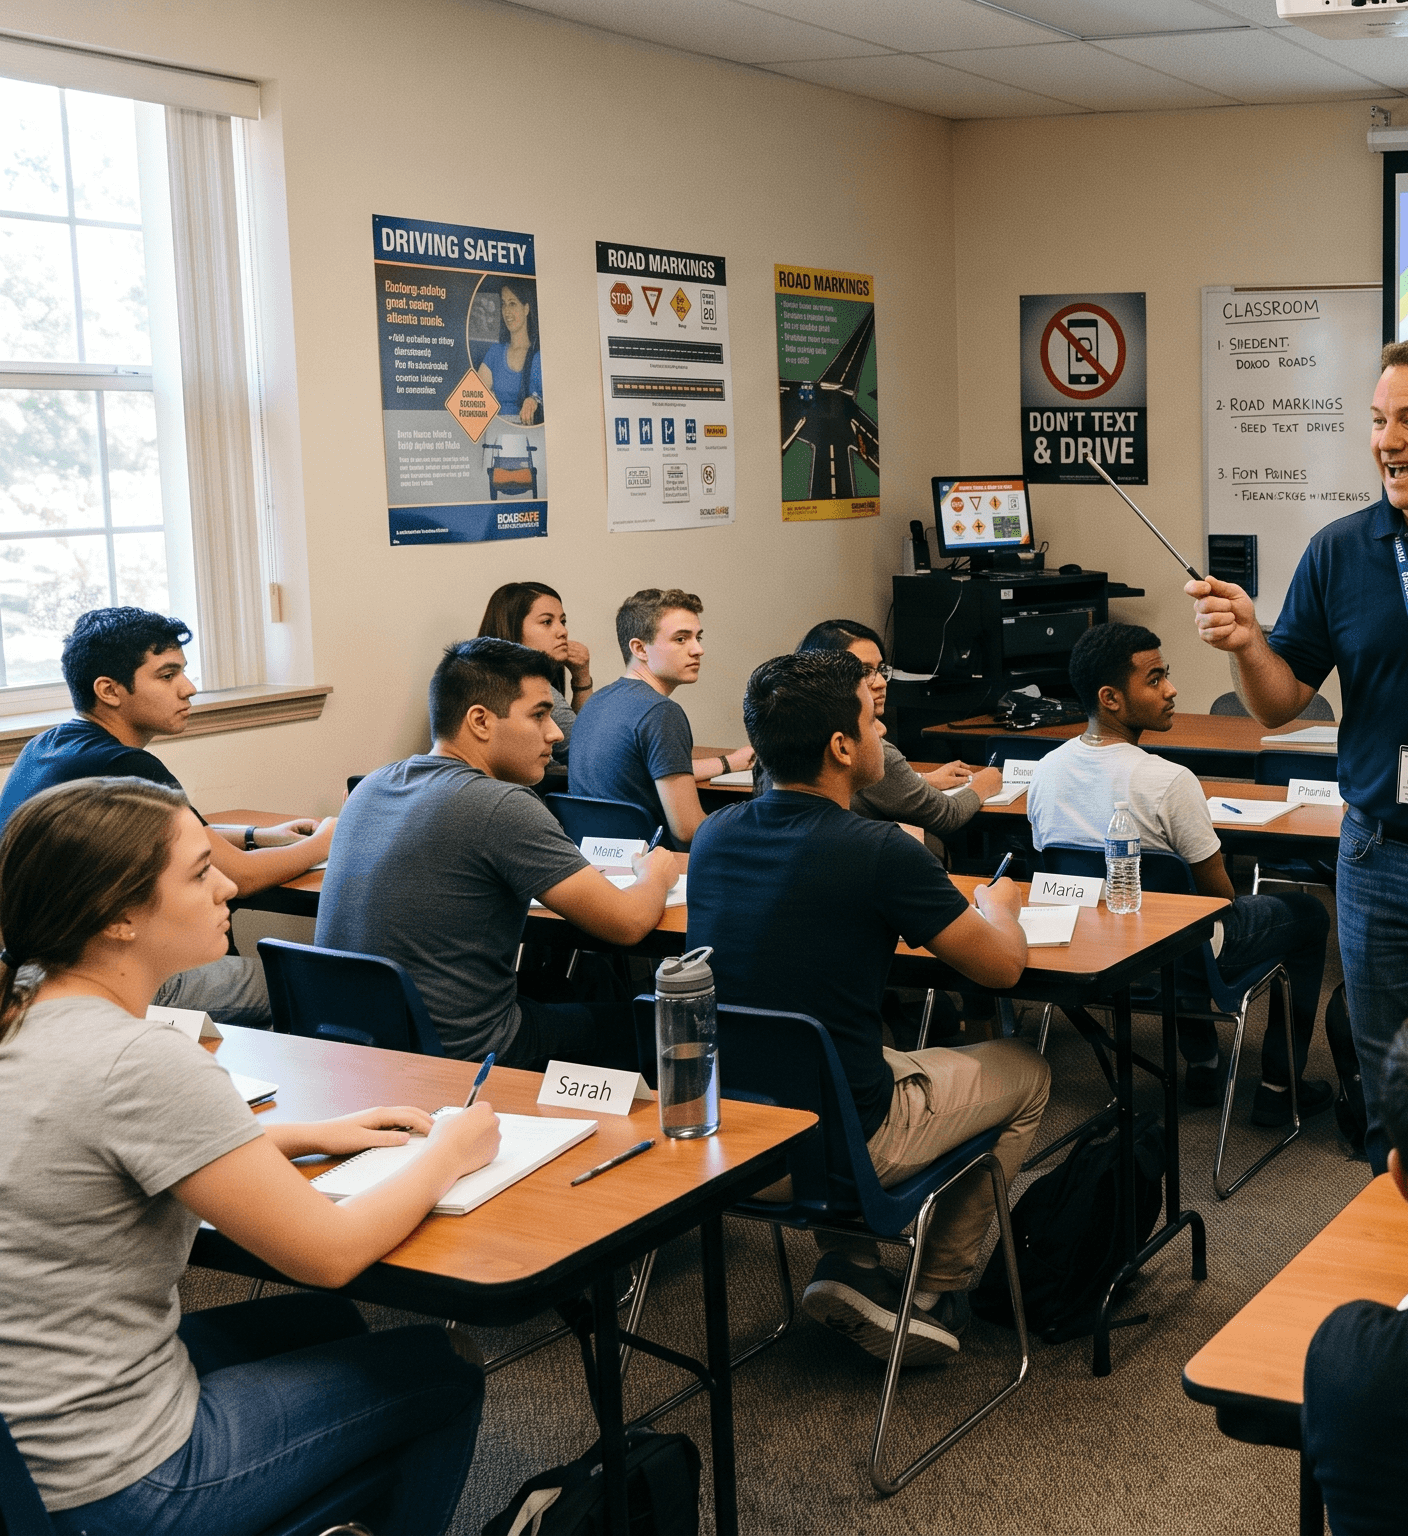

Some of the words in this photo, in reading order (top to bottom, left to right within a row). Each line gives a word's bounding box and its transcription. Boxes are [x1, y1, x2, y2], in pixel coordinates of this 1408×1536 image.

[381, 228, 459, 258] DRIVING
[464, 237, 526, 265] SAFETY
[608, 249, 645, 271] ROAD
[649, 254, 716, 279] MARKINGS
[779, 271, 811, 289] ROAD
[814, 275, 869, 296] MARKINGS
[611, 292, 632, 305] STOP
[1223, 300, 1319, 319] CLASSROOM
[1279, 356, 1316, 367] ROADS
[1230, 397, 1265, 411] ROAD
[1273, 397, 1343, 410] MARKINGS
[1029, 412, 1085, 431] DON'T
[1091, 412, 1138, 431] TEXT
[1272, 423, 1299, 432] TEXT
[1306, 422, 1345, 432] DRIVES
[1033, 436, 1052, 464] &
[1060, 437, 1134, 464] DRIVE
[1043, 881, 1085, 898] Maria
[556, 1076, 612, 1101] Sarah
